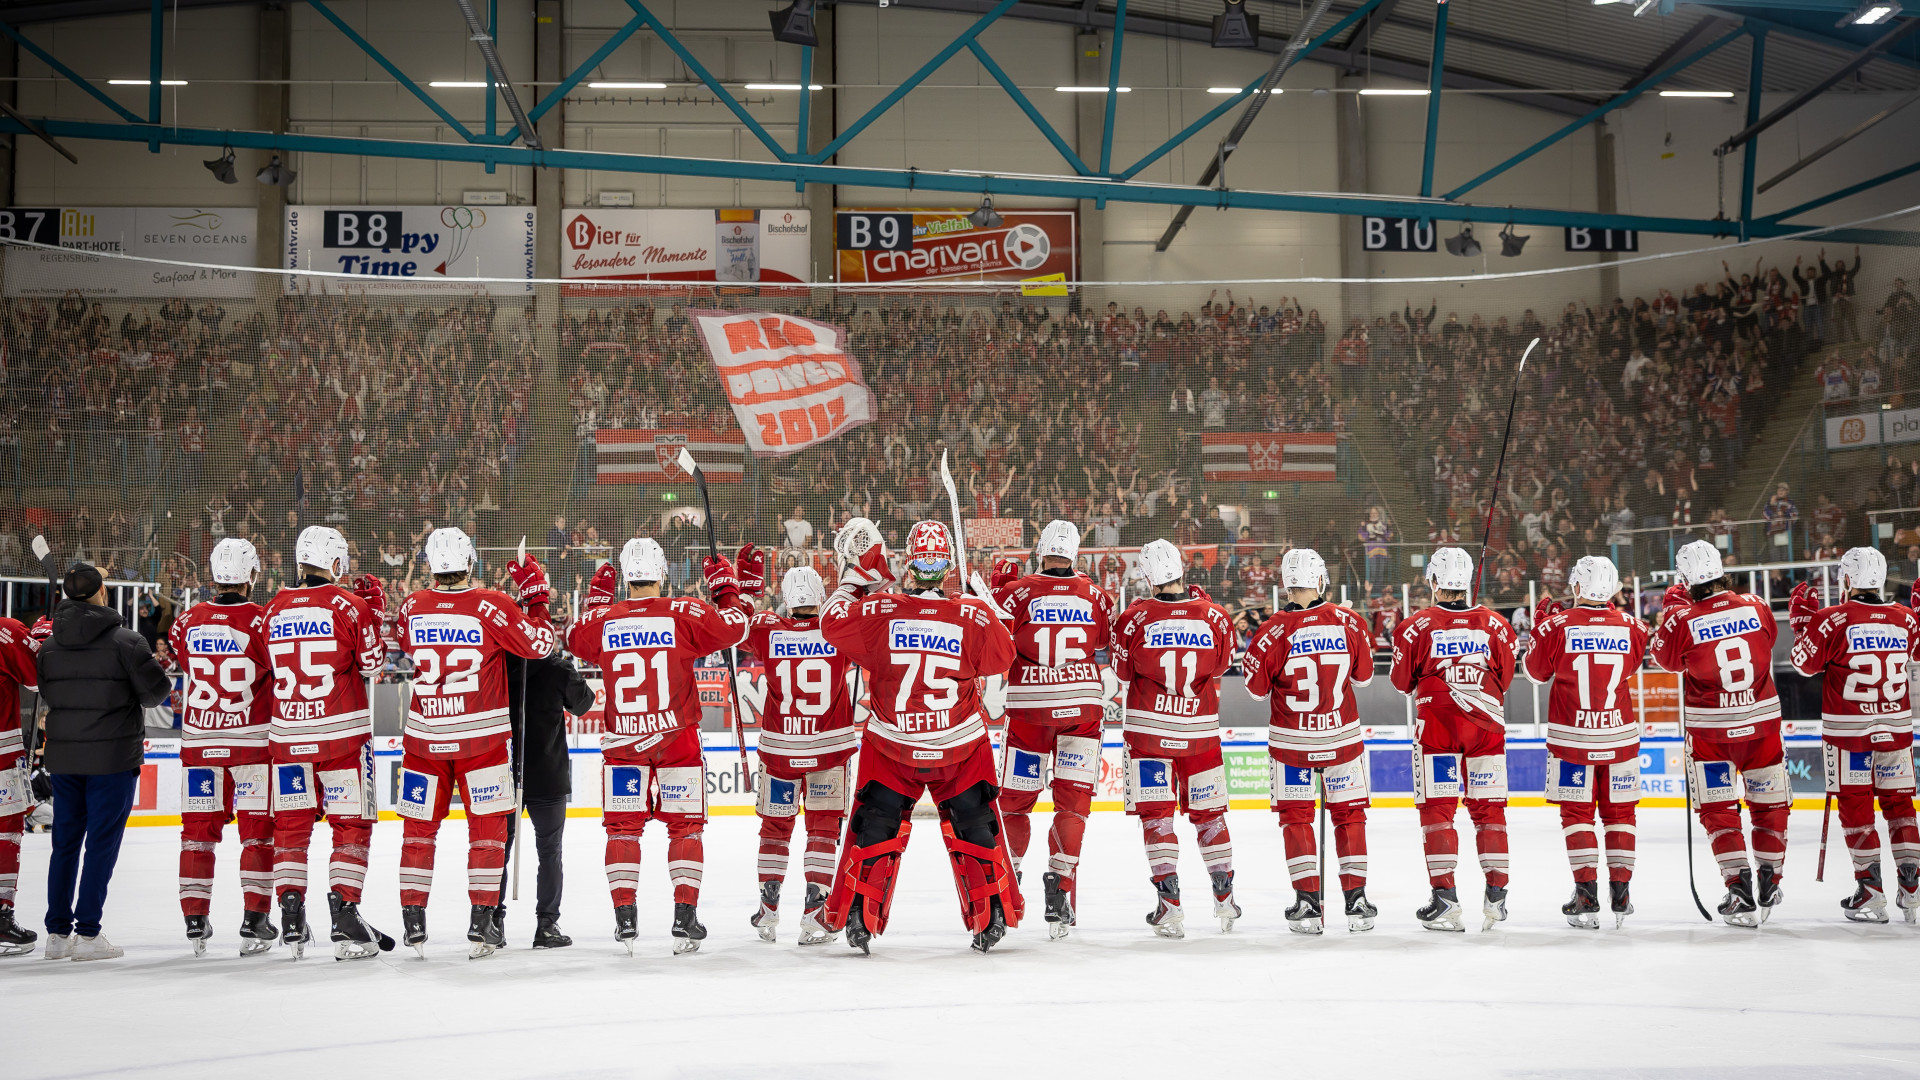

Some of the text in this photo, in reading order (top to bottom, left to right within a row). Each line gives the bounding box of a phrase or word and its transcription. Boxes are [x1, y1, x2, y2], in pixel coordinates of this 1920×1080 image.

[768, 223, 808, 233] Bischofshof
[912, 217, 974, 236] ehr Vielfalt
[144, 234, 248, 244] SEVEN OCEANS
[625, 232, 641, 247] für
[525, 212, 534, 292] www.htvr.de
[572, 245, 707, 271] besondere Momente
[872, 239, 998, 274] charivari
[338, 255, 417, 277] Time
[926, 267, 939, 275] der
[940, 264, 968, 274] bessere
[153, 268, 237, 287] Seafood & More
[331, 594, 352, 611] FT
[477, 600, 498, 618] FT
[670, 600, 689, 613] FT
[862, 600, 879, 616] FT
[1002, 594, 1017, 613] FT
[582, 608, 598, 626] FT
[750, 613, 767, 626] FT
[960, 604, 977, 620] FT
[1207, 607, 1224, 624] FT
[1335, 609, 1350, 624] FT
[1621, 612, 1635, 625] FT
[270, 620, 333, 639] REWAG
[1488, 615, 1503, 630] FT
[1538, 619, 1552, 637] FT
[1664, 614, 1677, 633] FT
[1698, 617, 1760, 641] REWAG
[1818, 618, 1834, 639] FT
[415, 628, 481, 643] REWAG
[608, 631, 674, 649] REWAG
[1150, 633, 1212, 647] REWAG
[1257, 633, 1273, 653] FT
[1402, 624, 1419, 644] FT
[193, 638, 240, 653] REWA
[774, 642, 835, 656] REWAG
[895, 633, 961, 654] REWAG
[1034, 627, 1088, 669] 16
[1290, 637, 1346, 655] REWAG
[1571, 638, 1629, 651] REWAG
[268, 640, 338, 700] 55
[412, 648, 484, 695] 22
[1020, 663, 1099, 684] ZERRESSEN
[1714, 636, 1755, 693] 8
[612, 650, 671, 714] 21
[694, 670, 727, 682] ARTY
[890, 653, 962, 712] 75
[1160, 650, 1198, 698] 11
[1284, 653, 1351, 712] 37
[1572, 653, 1624, 710] 17
[1842, 652, 1909, 702] 28
[187, 657, 256, 712] 69
[775, 658, 832, 715] 19
[279, 699, 326, 720] WEBER
[420, 695, 465, 716] GRIMM
[1154, 694, 1201, 716] BAUER
[614, 709, 679, 735] ANGARAN
[784, 716, 820, 735] ONTL
[896, 710, 950, 732] NEFFIN
[1298, 710, 1343, 731] LEDEN
[1575, 708, 1624, 729] PAYEUR
[1057, 758, 1078, 767] Time
[1058, 750, 1084, 761] Happy
[1229, 756, 1244, 765] VR
[1325, 775, 1351, 784] Happy
[1412, 743, 1421, 798] VECTOR
[1612, 775, 1636, 783] Happy
[470, 783, 500, 795] Happy
[660, 783, 687, 792] Happy
[1012, 777, 1040, 785] ECKERT
[1327, 783, 1346, 791] Time
[279, 794, 308, 803] ECKERT
[472, 793, 495, 803] Time
[661, 791, 682, 799] Time
[1558, 787, 1585, 795] ECKERT
[1707, 788, 1734, 796] ECKERT
[188, 798, 216, 806] ECKERT
